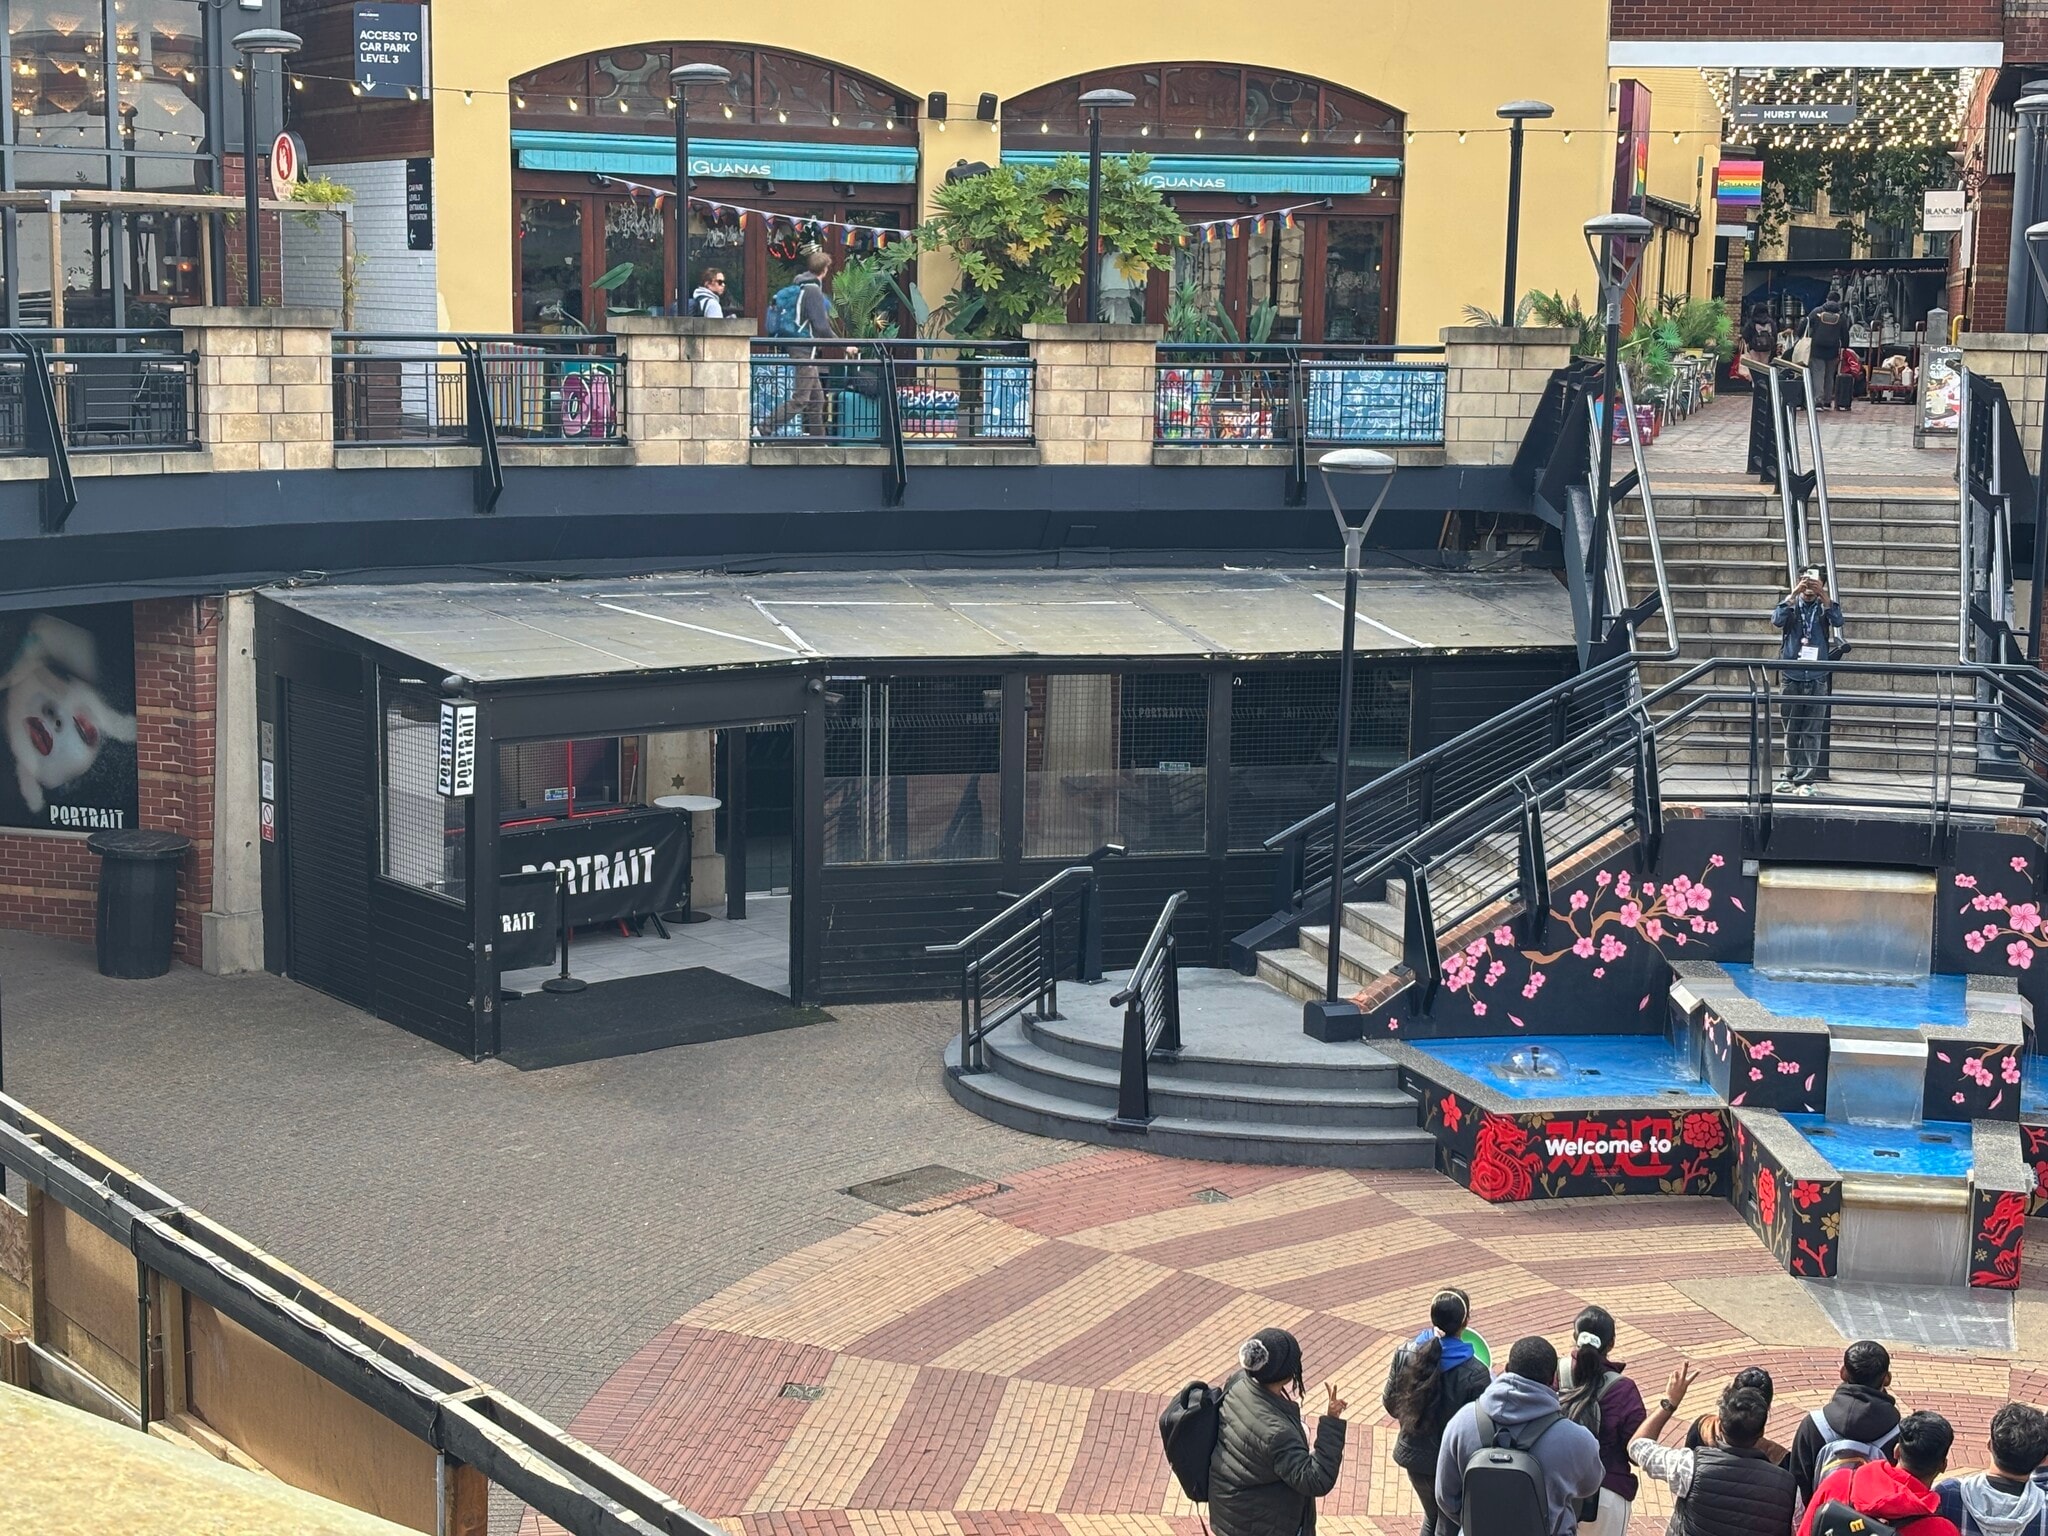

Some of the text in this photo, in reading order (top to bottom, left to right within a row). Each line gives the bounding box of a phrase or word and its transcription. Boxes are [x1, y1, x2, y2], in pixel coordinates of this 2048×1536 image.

[360, 30, 418, 41] ACCESS TO
[360, 42, 410, 53] CAR PARK
[360, 53, 399, 64] LEVEL 3
[1763, 110, 1796, 119] HURST
[1799, 110, 1828, 119] WALK
[688, 160, 771, 175] IGUANAS
[1144, 175, 1226, 189] IGUANAS
[440, 711, 453, 788] PORTRAIT
[457, 714, 474, 789] PORTRAIT
[50, 805, 124, 829] PORTRAIT
[522, 847, 656, 895] RTRAIT
[500, 911, 536, 933] RAIT
[1545, 1136, 1671, 1156] Welcome to
